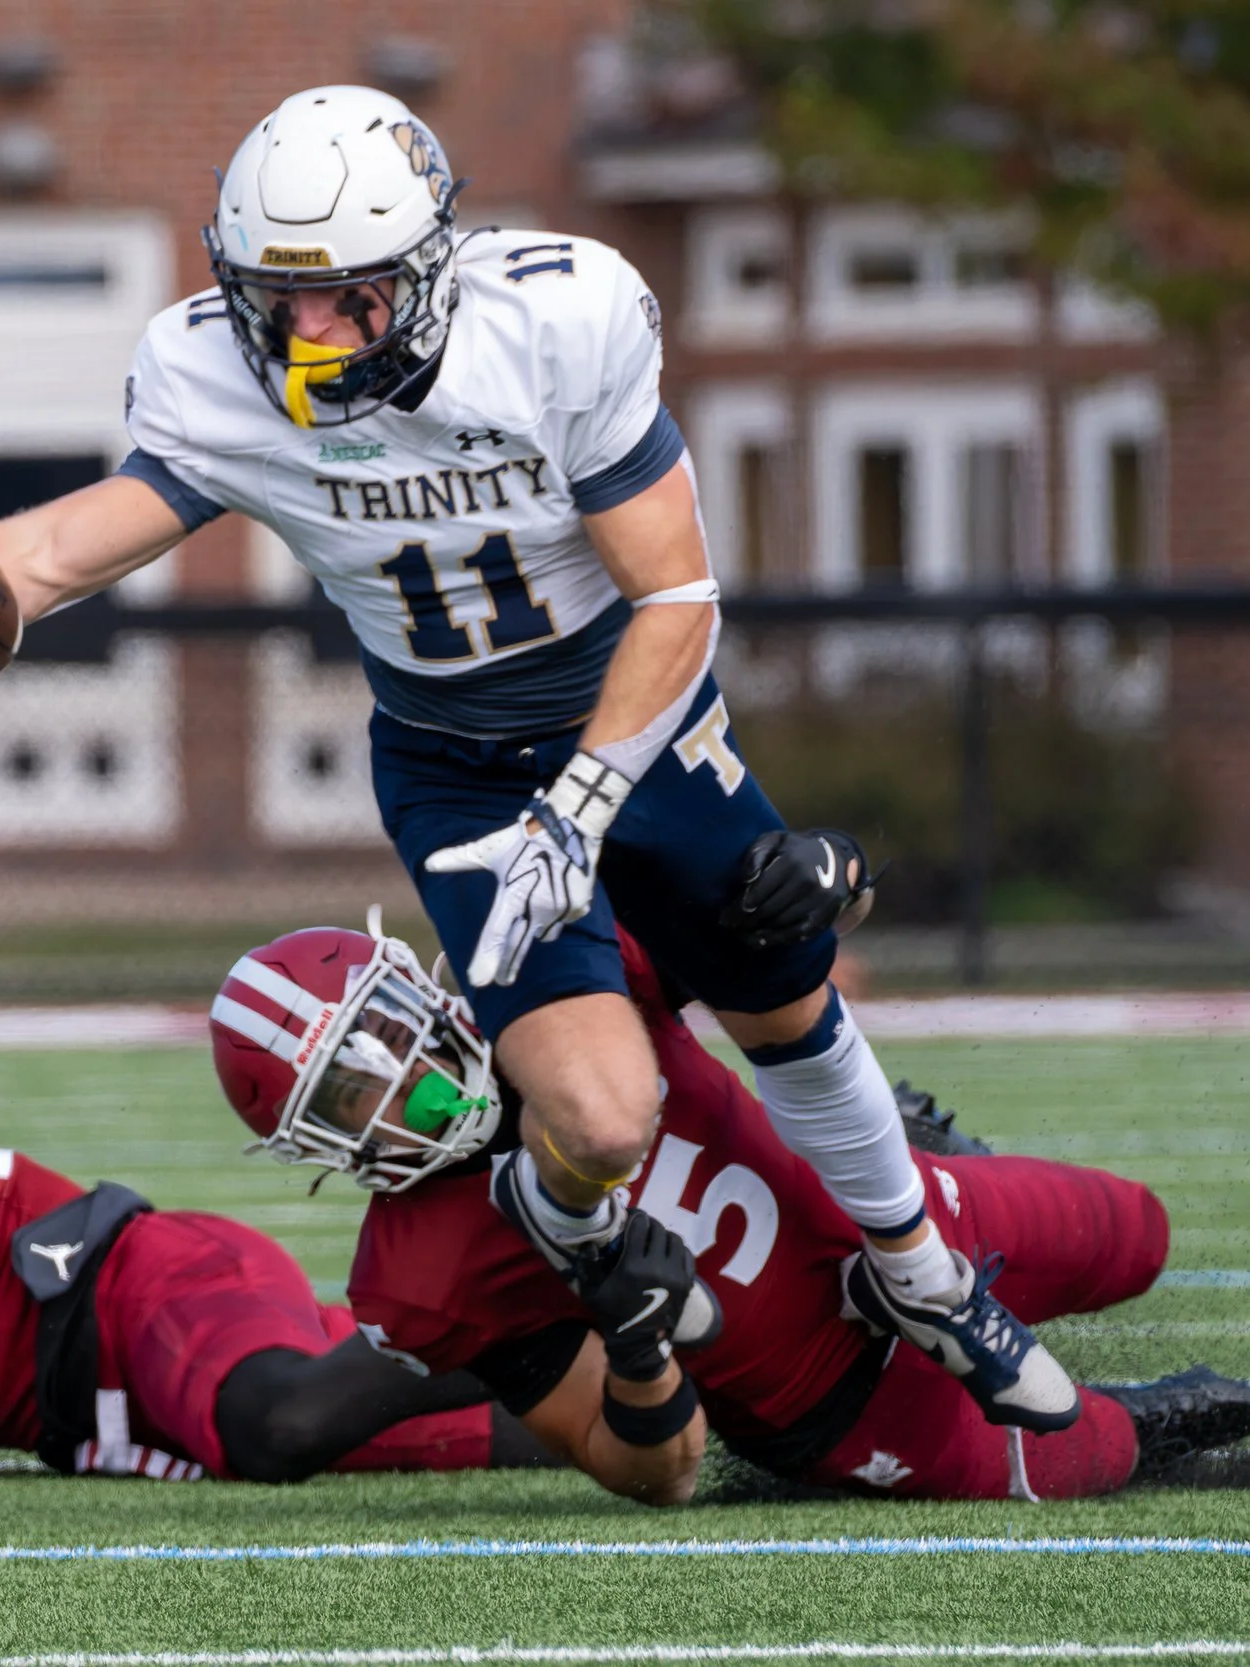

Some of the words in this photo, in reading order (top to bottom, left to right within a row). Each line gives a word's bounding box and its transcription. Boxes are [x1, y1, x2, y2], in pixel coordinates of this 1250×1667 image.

[266, 249, 323, 265] TRINITY
[315, 456, 549, 522] TRINITY
[377, 529, 561, 664] 11
[673, 693, 746, 798] T
[296, 1008, 335, 1066] Riddell
[636, 1131, 780, 1288] 5
